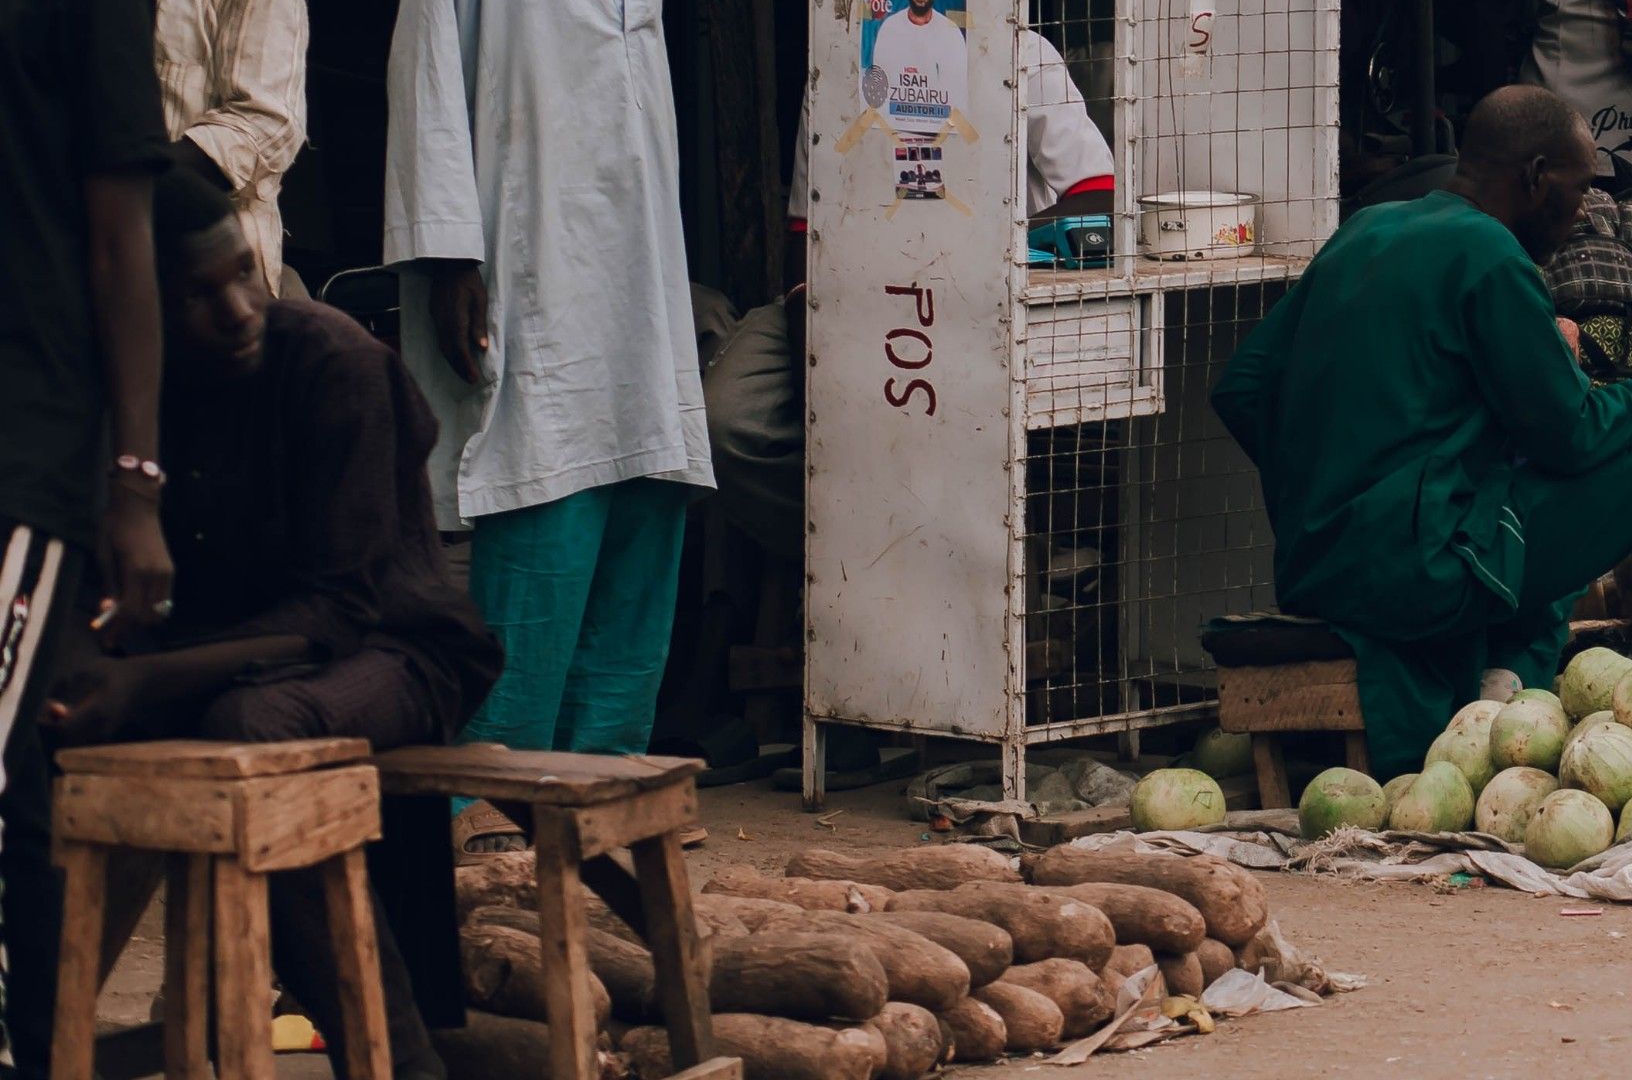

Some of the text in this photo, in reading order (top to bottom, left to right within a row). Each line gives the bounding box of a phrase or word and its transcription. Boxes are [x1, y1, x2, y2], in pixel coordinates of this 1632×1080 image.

[899, 73, 928, 88] ISAH
[889, 87, 949, 104] ZUBAIRU
[895, 105, 936, 116] AUDITOR
[884, 284, 936, 417] POS
